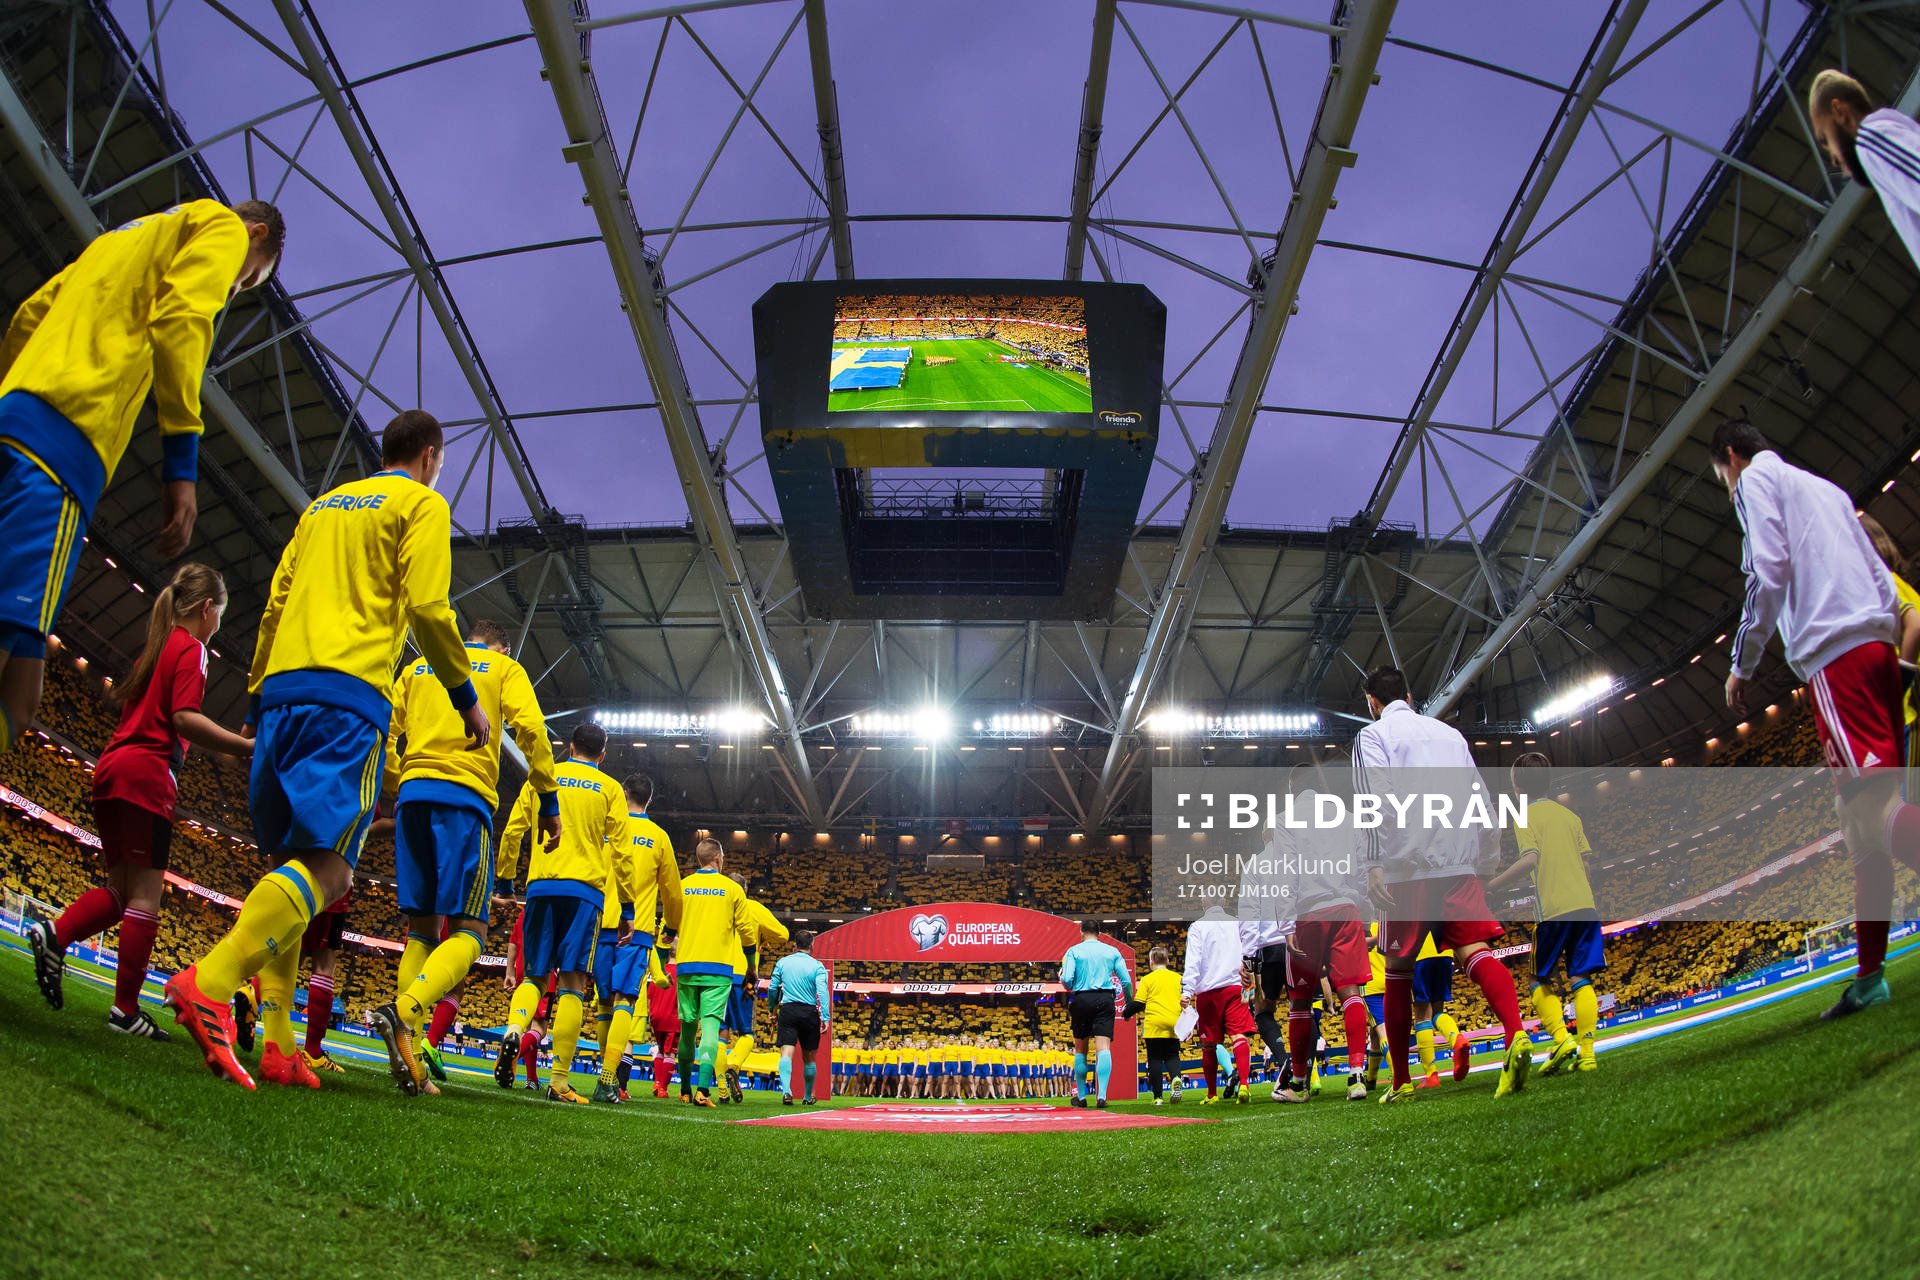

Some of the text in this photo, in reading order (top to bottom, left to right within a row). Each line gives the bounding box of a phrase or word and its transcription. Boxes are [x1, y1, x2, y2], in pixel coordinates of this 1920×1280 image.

[1105, 415, 1136, 424] friends
[309, 494, 388, 515] SVERIGE
[684, 887, 726, 897] SVERIGE
[955, 923, 1014, 933] EUROPEAN
[948, 933, 1021, 946] QUALIFIERS
[903, 983, 952, 992] ODDSET
[994, 983, 1043, 992] ODDSET
